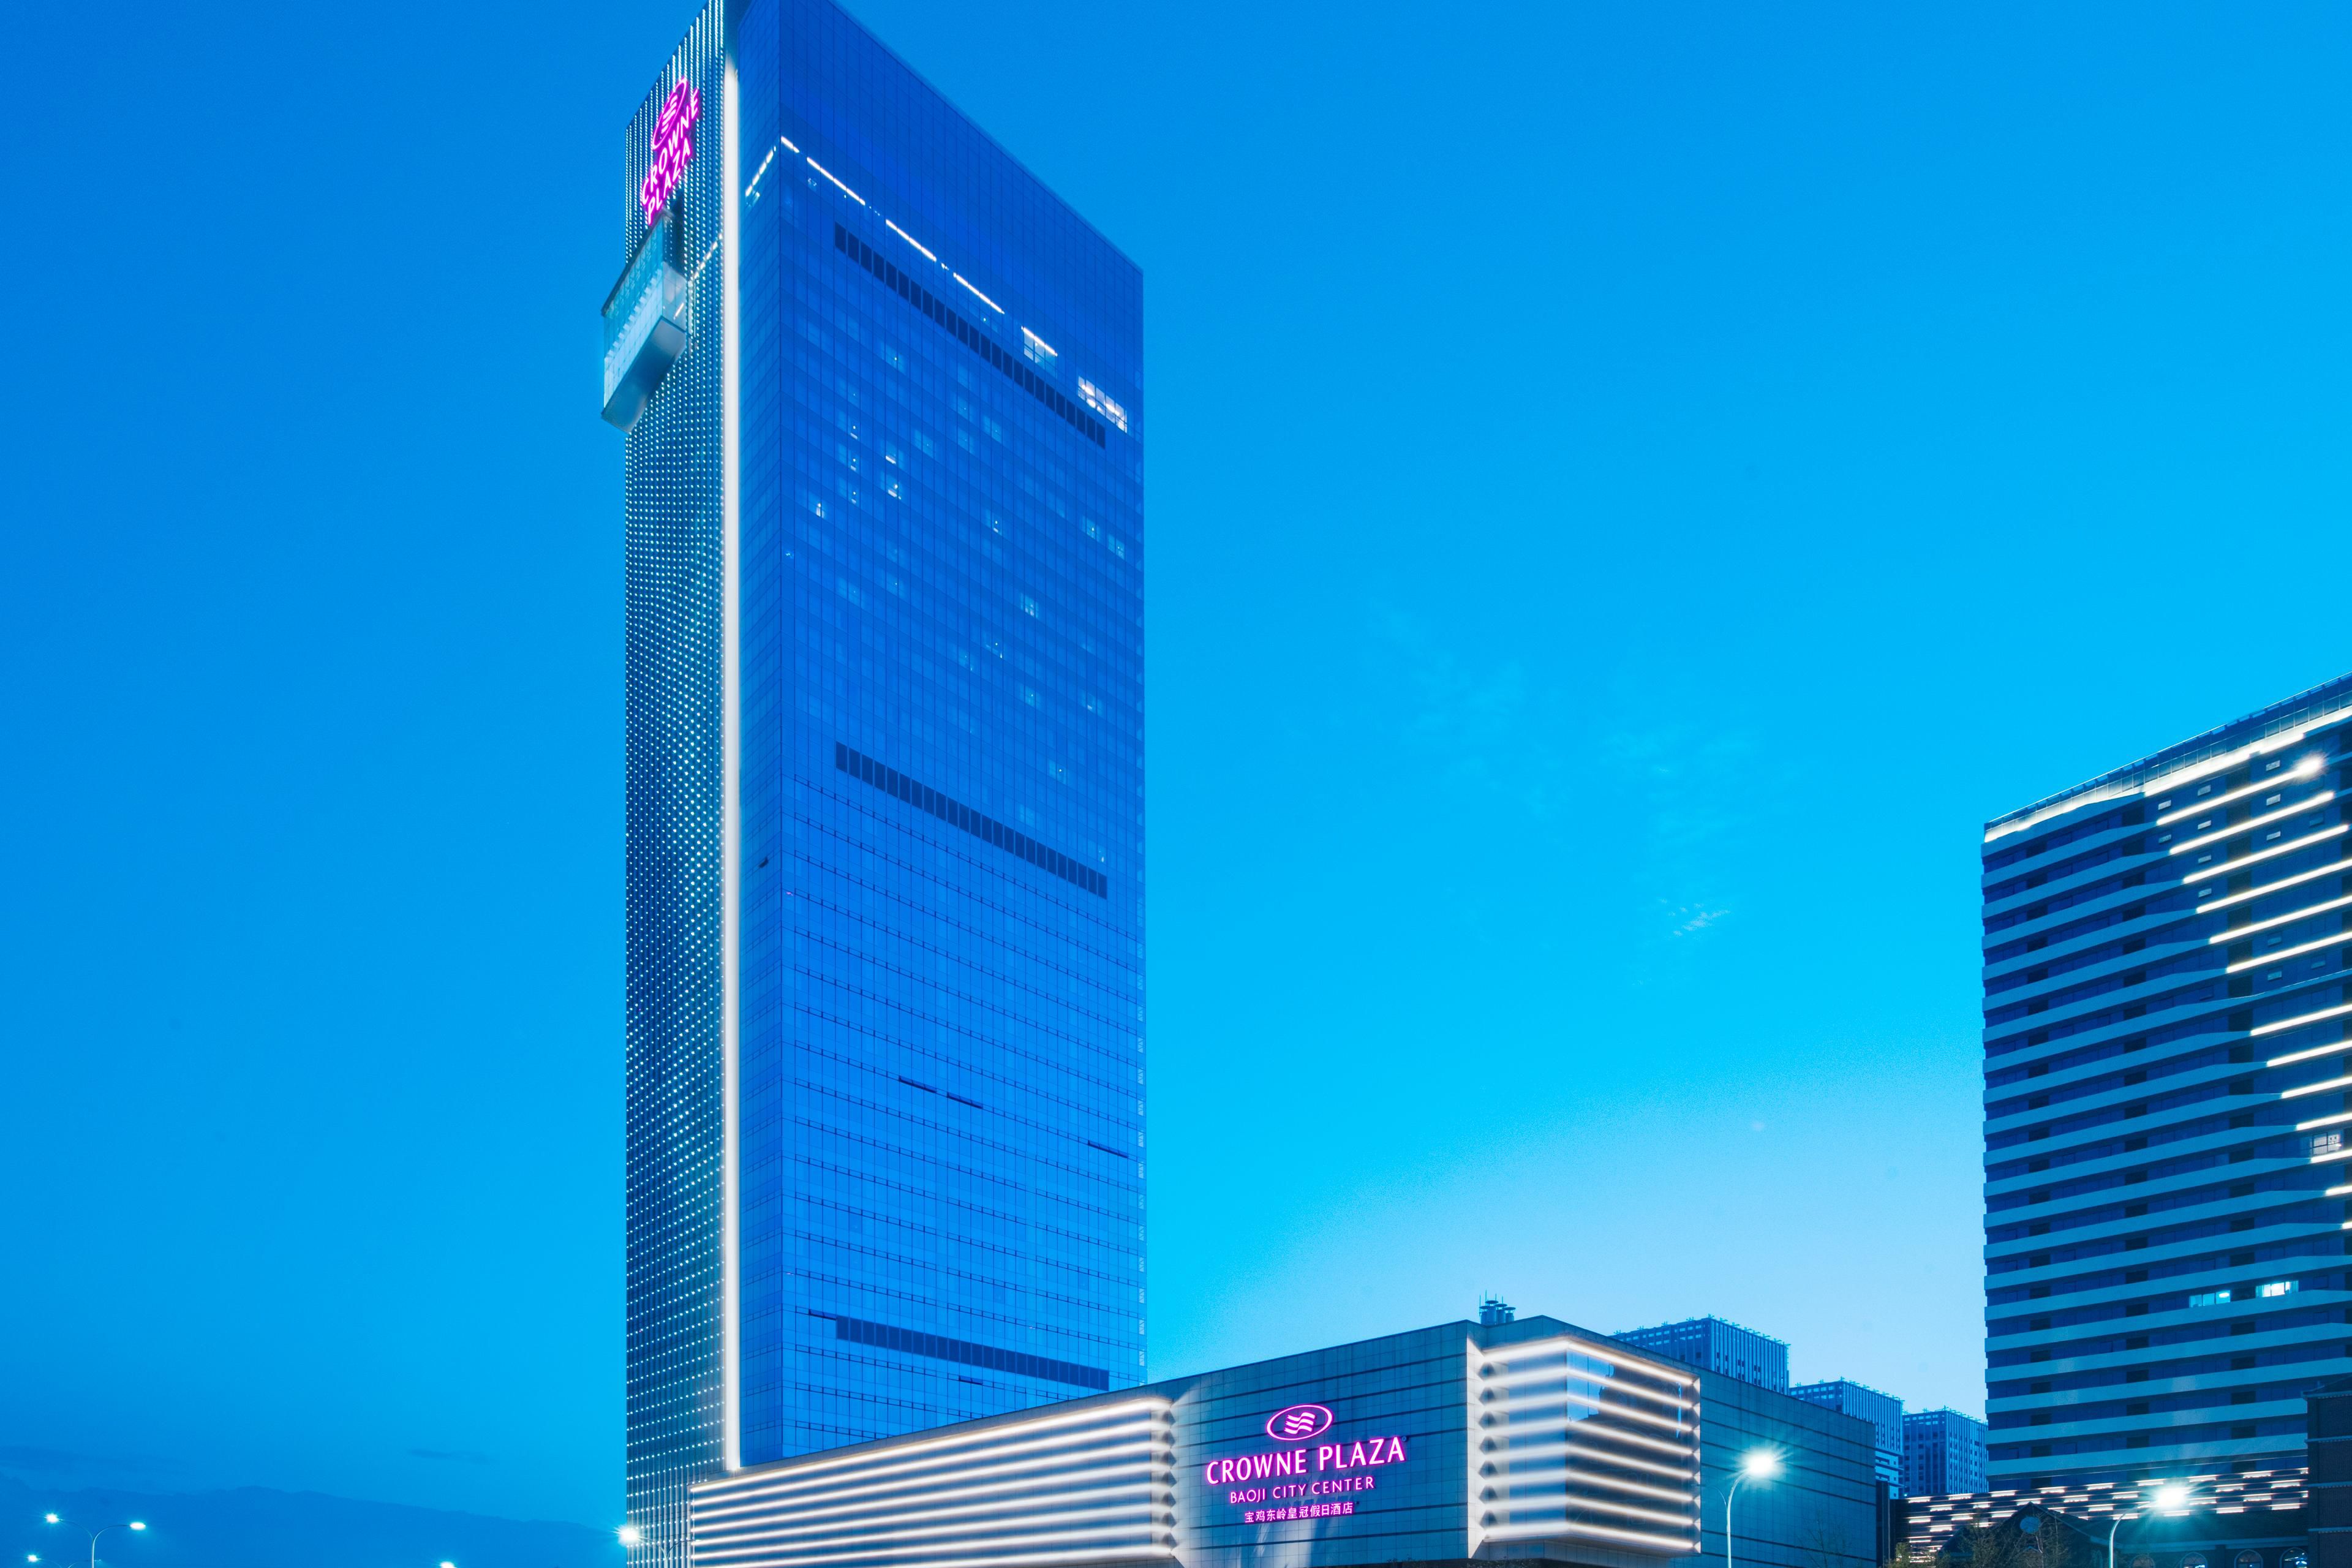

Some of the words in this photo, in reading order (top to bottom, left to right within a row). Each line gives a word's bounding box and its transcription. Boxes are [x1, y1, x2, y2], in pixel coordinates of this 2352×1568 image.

[642, 88, 699, 205] CROWNE
[647, 137, 690, 225] PLAZA
[1205, 1449, 1307, 1485] CROWNE
[1319, 1436, 1405, 1471] PLAZA
[1230, 1488, 1266, 1504] BAOJI
[1272, 1483, 1307, 1499] CITY
[1311, 1476, 1374, 1494] CENTER
[1245, 1501, 1354, 1523] 宝鸡东岭皇冠假日酒店
